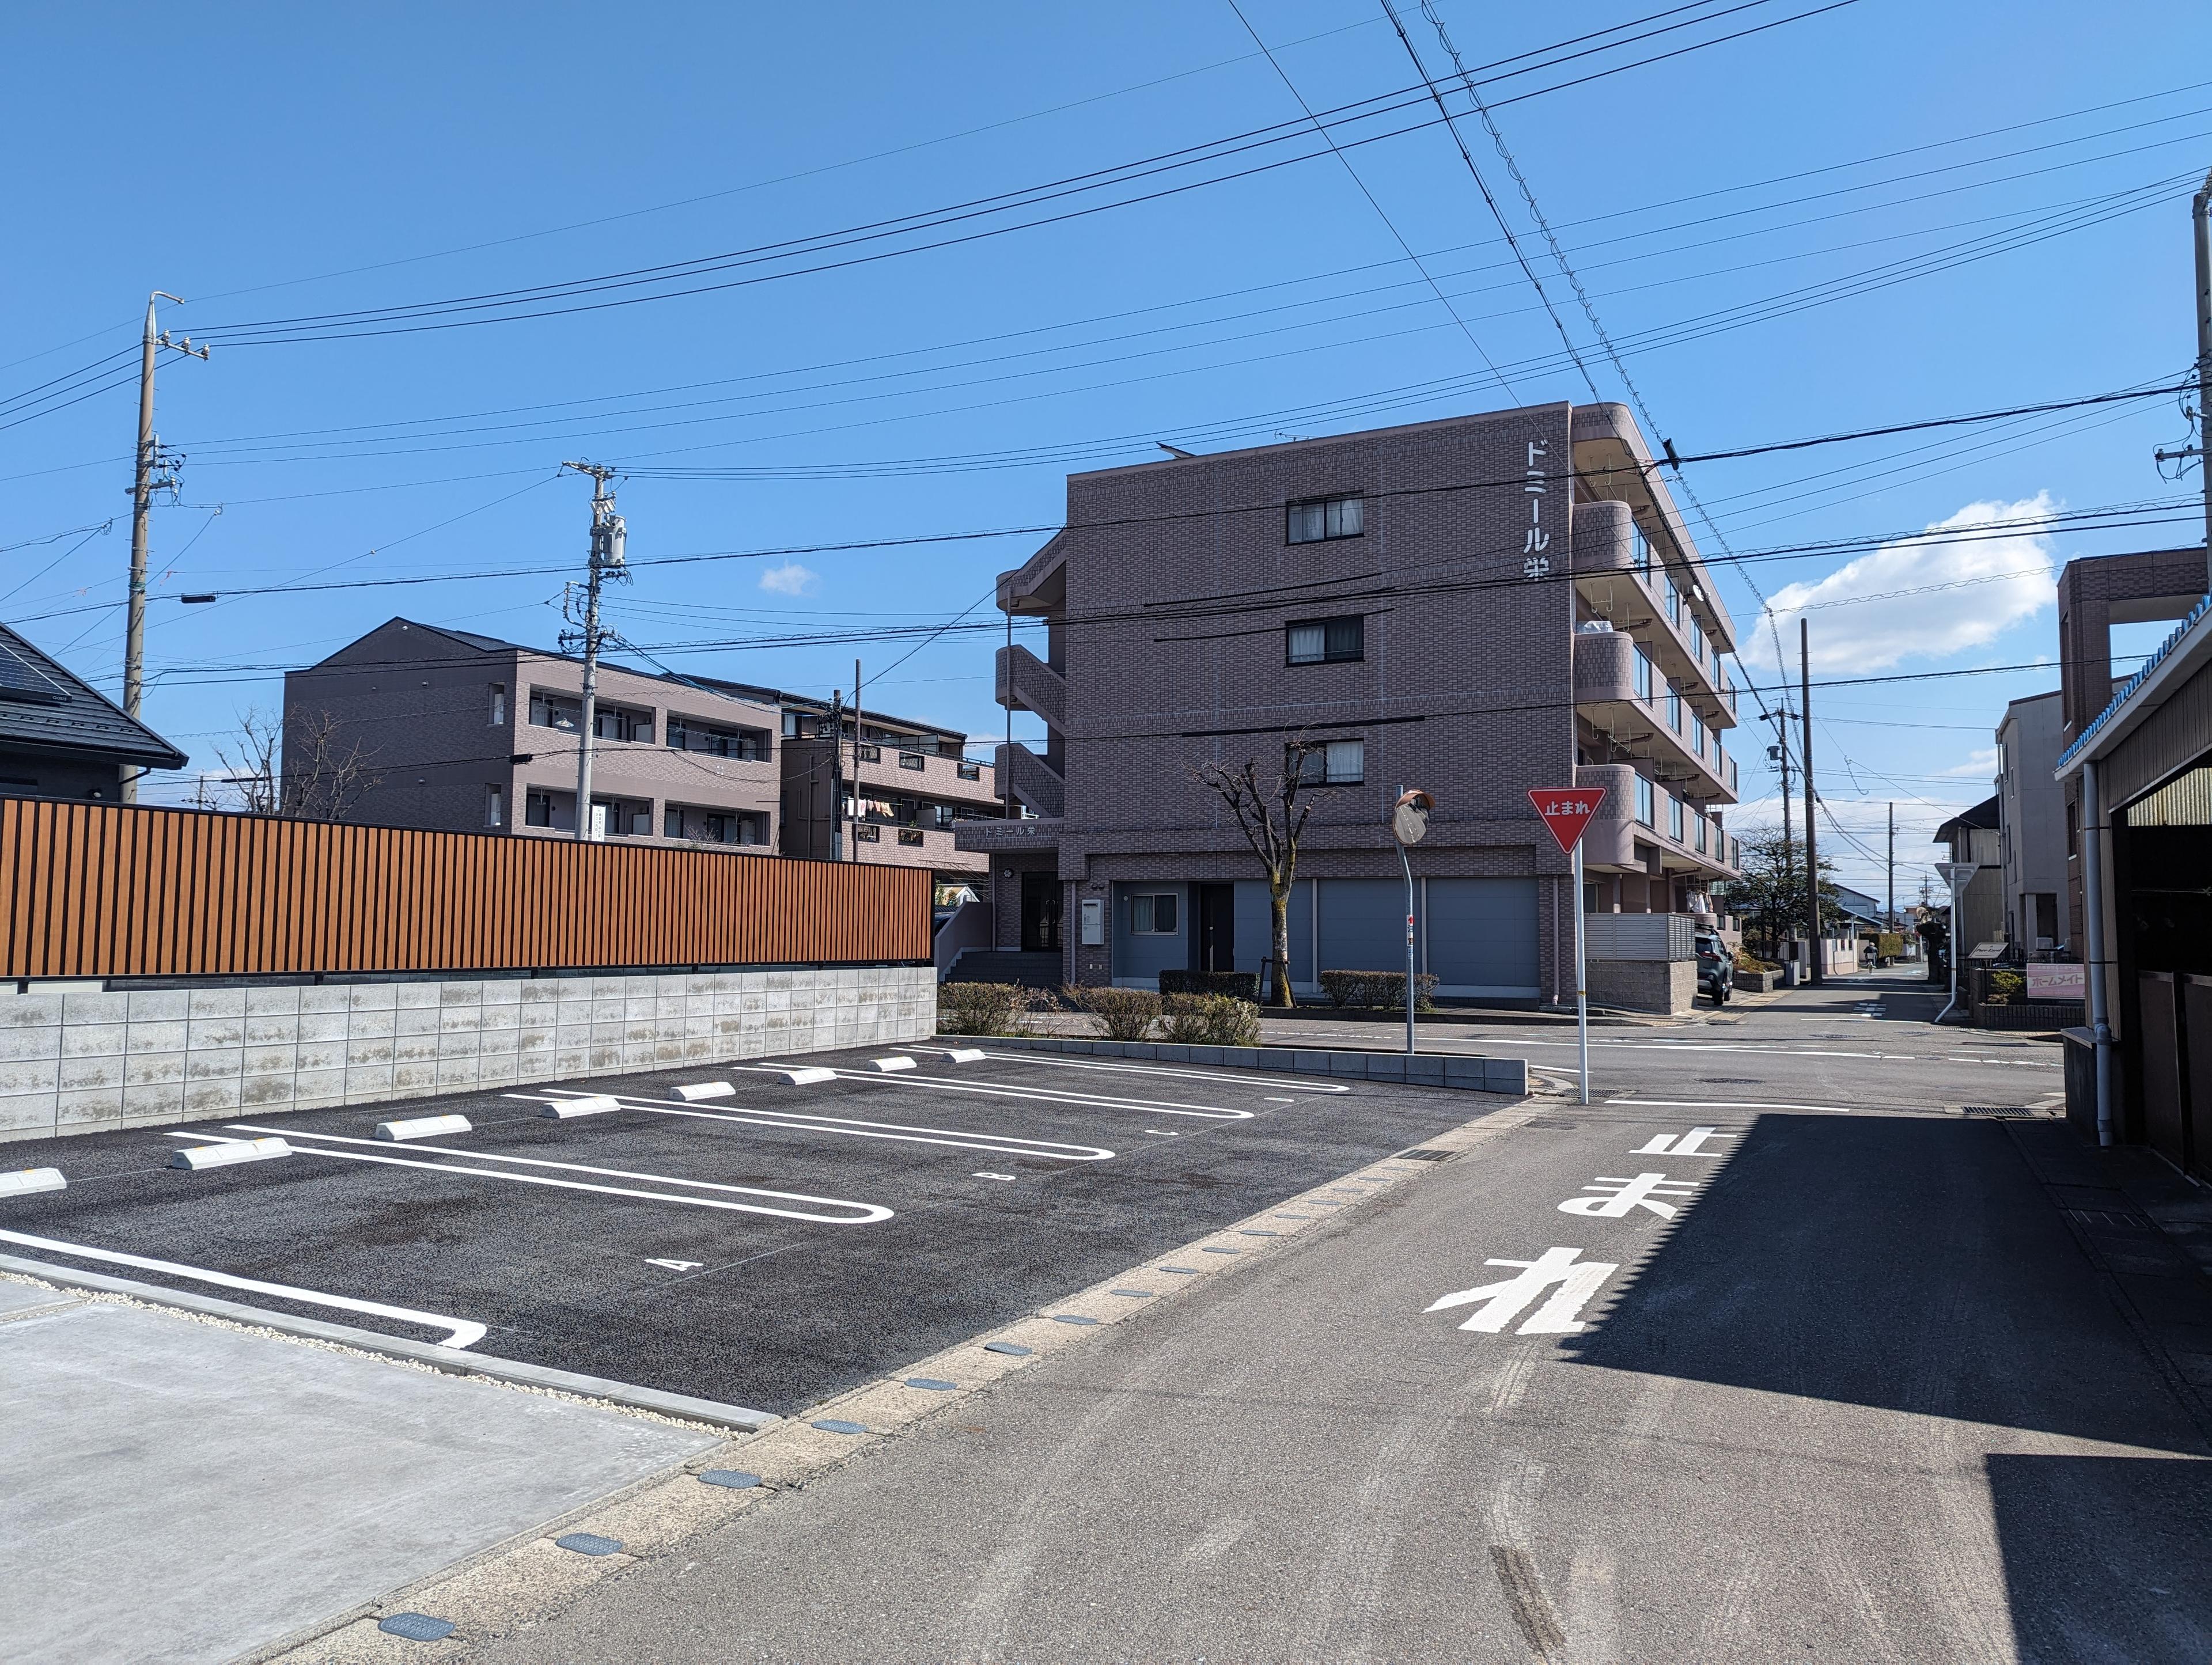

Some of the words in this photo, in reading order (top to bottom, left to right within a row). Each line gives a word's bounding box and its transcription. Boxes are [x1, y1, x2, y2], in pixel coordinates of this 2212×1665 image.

[1524, 439, 1550, 582] ドミール栄
[1544, 800, 1590, 816] 止まれ
[986, 825, 1035, 837] ドミール栄
[2032, 974, 2084, 987] ホームメイト
[971, 1172, 1016, 1181] B
[1422, 1127, 1737, 1335] 止まれ
[644, 1258, 703, 1272] A
